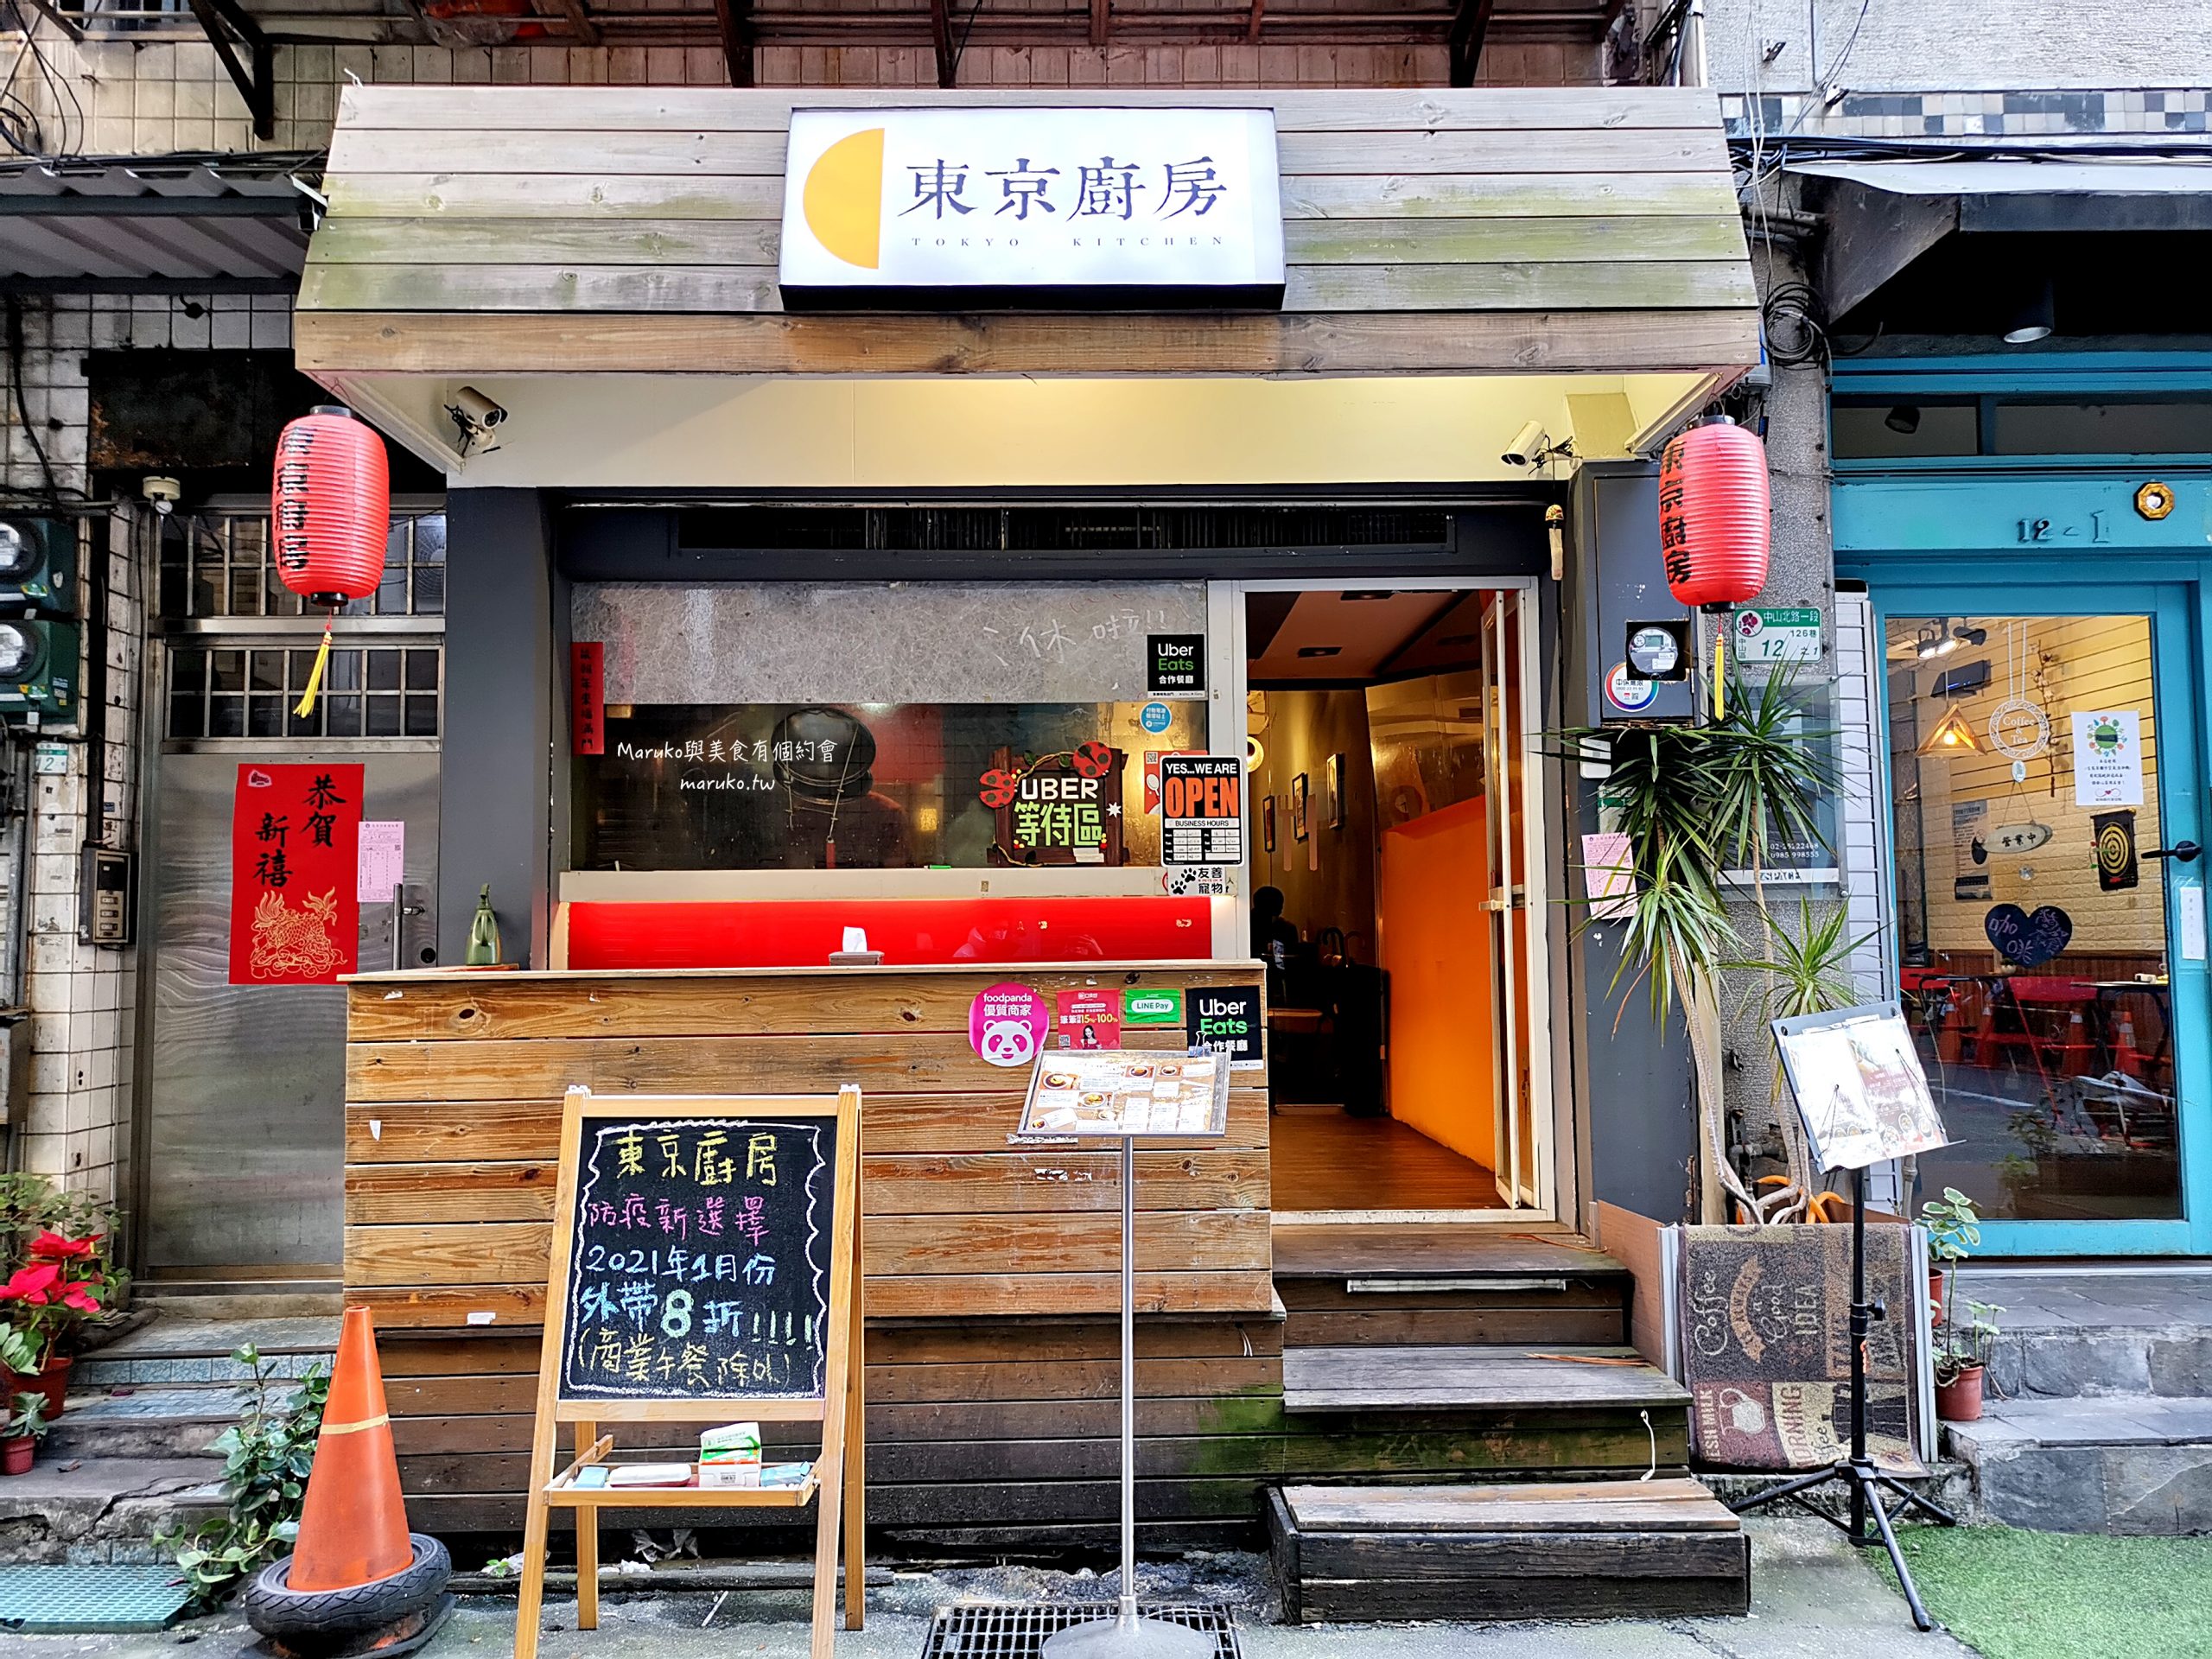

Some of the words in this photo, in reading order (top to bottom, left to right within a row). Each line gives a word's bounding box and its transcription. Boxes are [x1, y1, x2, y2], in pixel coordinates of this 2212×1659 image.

[897, 156, 1228, 222] 東京廚房
[912, 237, 1020, 247] TOKYO
[1072, 235, 1224, 247] KITCHEN
[1763, 610, 1819, 623] 中山北路一段
[1789, 629, 1817, 638] 126巷
[1158, 643, 1194, 657] Uber
[1761, 639, 1785, 657] 12
[1158, 658, 1194, 671] Eats
[1158, 675, 1194, 685] 合作餐廳
[2002, 716, 2036, 726] Coffee
[2011, 734, 2029, 744] Tea
[1214, 763, 1237, 774] ARE
[1020, 777, 1099, 801] UBER
[1165, 776, 1239, 818] OPEN
[300, 773, 346, 849] 恭賀
[1014, 801, 1103, 847] 等待區
[2001, 832, 2037, 848] 營業中
[252, 811, 294, 888] 新禧
[1198, 867, 1223, 879] 友善
[1198, 882, 1223, 894] 寵物
[983, 993, 1033, 1004] foodpanda
[1155, 1002, 1169, 1011] Pay
[983, 1003, 1032, 1016] 優質商家
[1199, 999, 1247, 1016] Uber
[1200, 1018, 1248, 1035] Eats
[614, 1130, 778, 1186] 東京廚房
[588, 1193, 771, 1246] 防疫新選擇
[586, 1245, 777, 1285] 2021年1月份
[1694, 1270, 1729, 1356] Coffee
[1760, 1283, 1790, 1344] Good
[1795, 1284, 1818, 1336] IDEA
[1699, 1389, 1716, 1426] MILK
